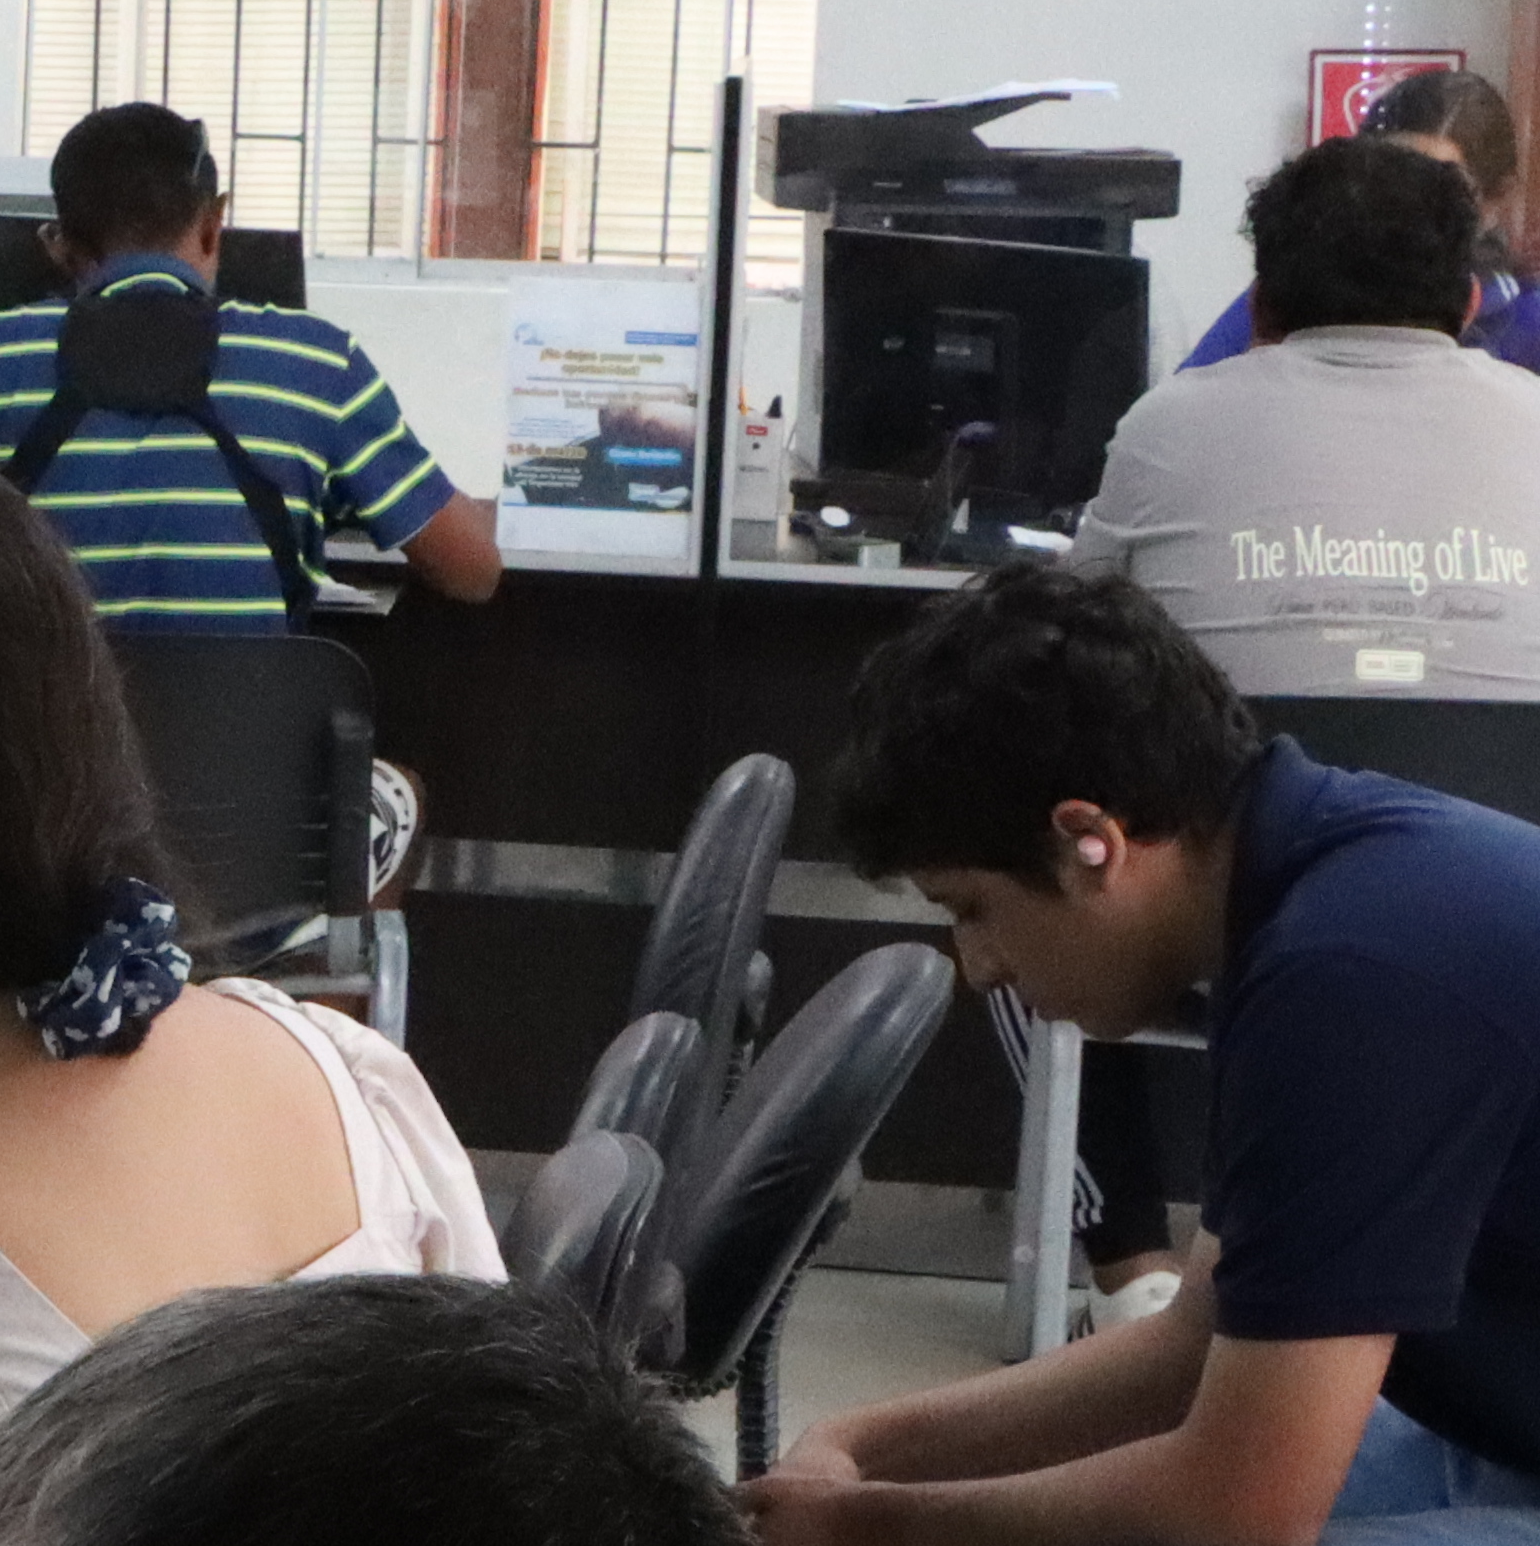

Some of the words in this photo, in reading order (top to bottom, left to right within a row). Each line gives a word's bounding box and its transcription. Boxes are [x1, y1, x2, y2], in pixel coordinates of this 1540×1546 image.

[1231, 529, 1286, 580] The
[1294, 525, 1428, 596] Meaning
[1435, 527, 1465, 580] of
[1471, 529, 1529, 586] Live
